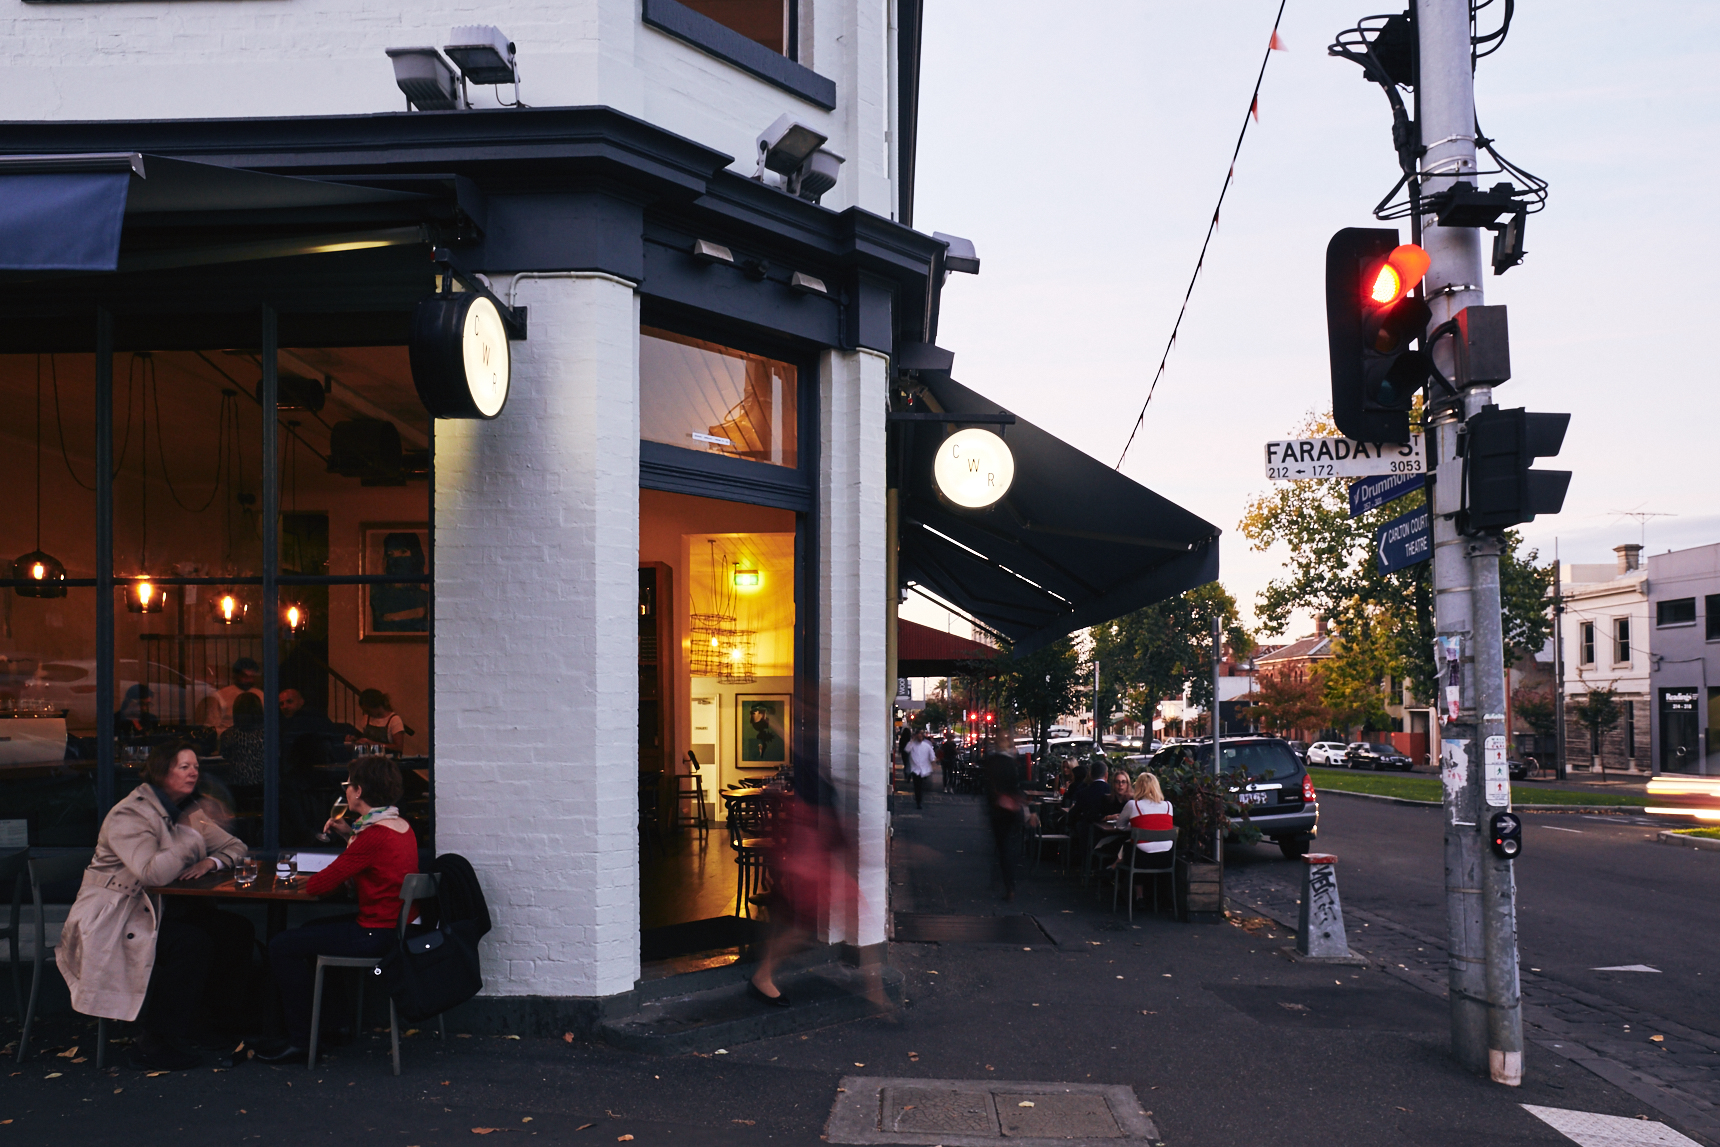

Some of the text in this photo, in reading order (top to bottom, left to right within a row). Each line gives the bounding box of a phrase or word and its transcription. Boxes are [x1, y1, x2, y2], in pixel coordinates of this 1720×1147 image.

[1267, 441, 1383, 464] FARADAY
[1268, 460, 1422, 479] 212 172 3053
[1388, 513, 1429, 544] CARLTON COURT
[1405, 536, 1428, 557] THEATRE
